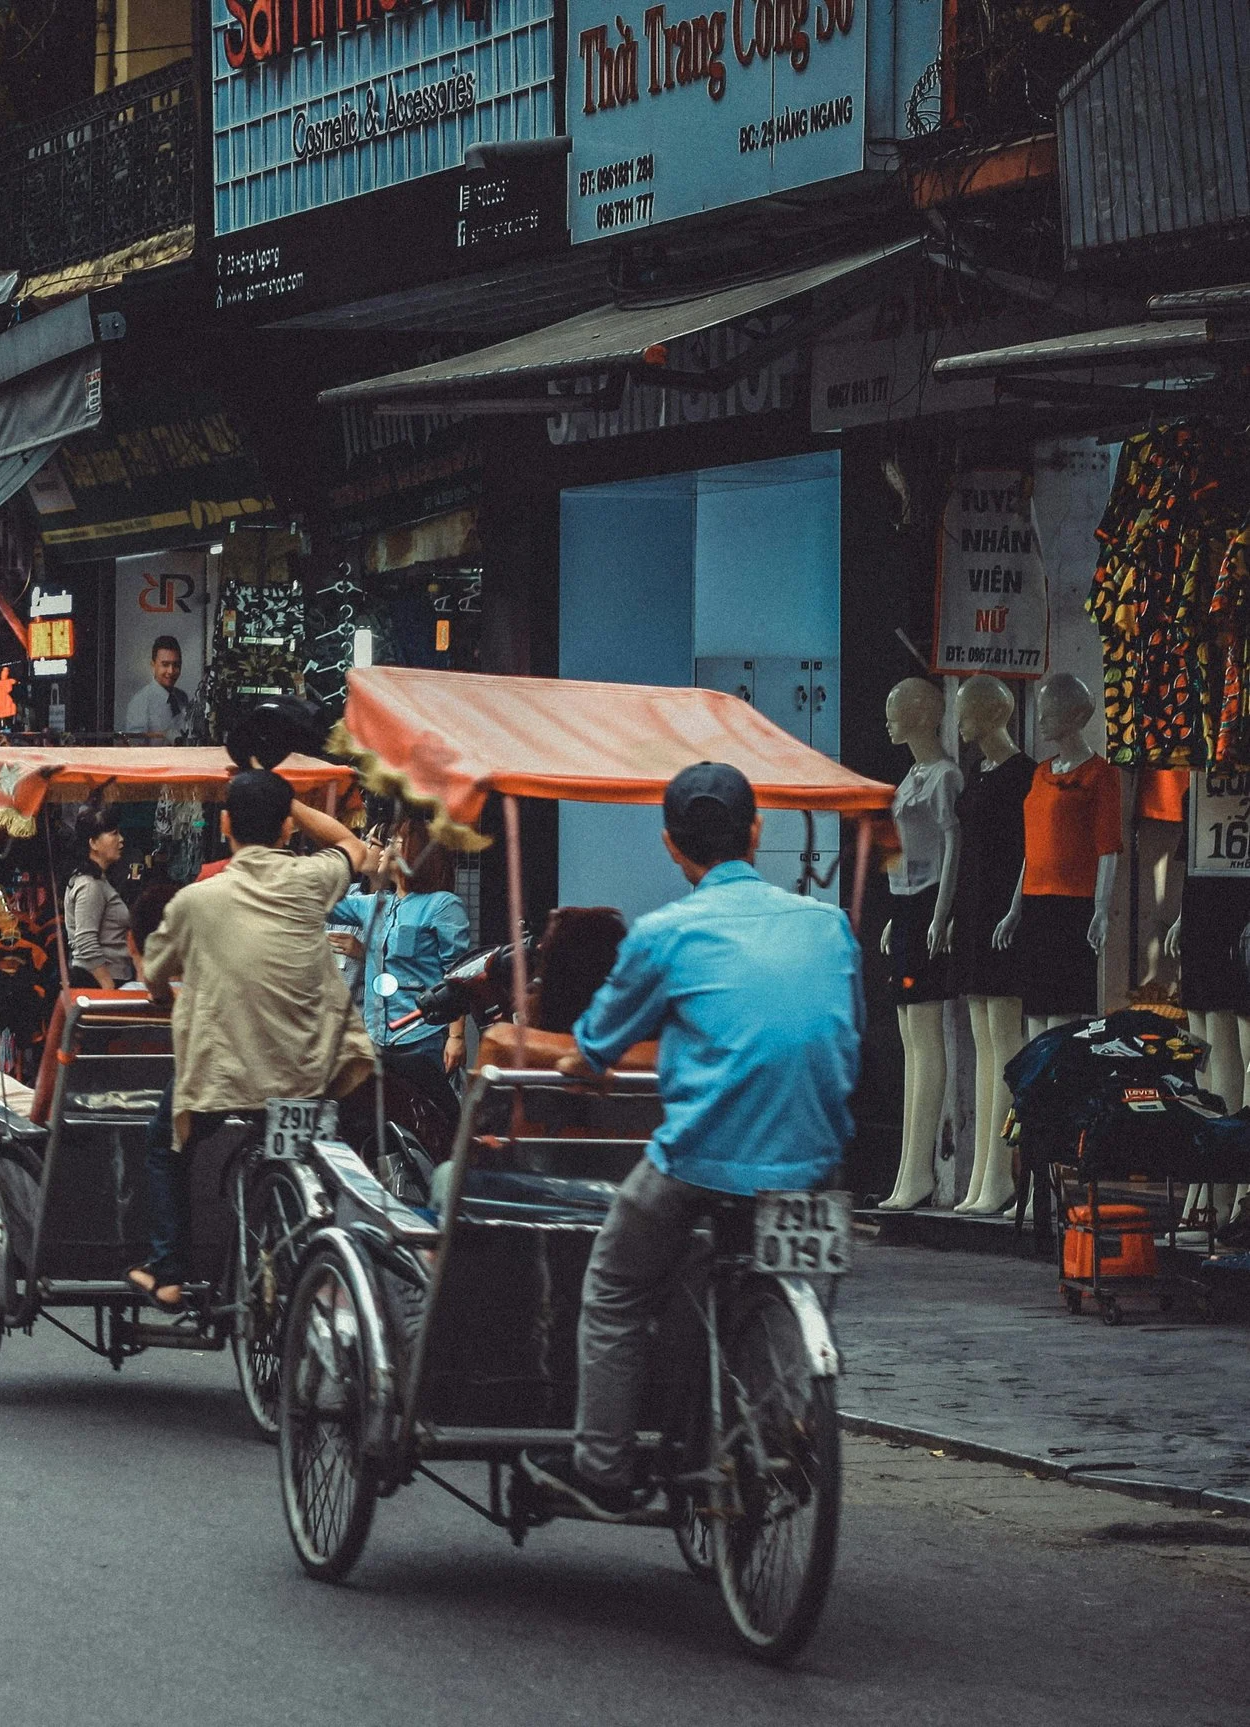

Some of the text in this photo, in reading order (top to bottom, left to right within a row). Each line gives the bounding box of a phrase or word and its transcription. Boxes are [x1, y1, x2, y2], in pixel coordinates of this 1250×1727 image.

[644, 4, 726, 100] Trang
[292, 64, 477, 158] Cosmetic & Accessories
[775, 105, 807, 142] HÀNG
[810, 95, 853, 132] NGANG
[961, 525, 1031, 553] NHÂN
[968, 565, 1023, 593] VIÊN
[975, 605, 1010, 633] NỮ
